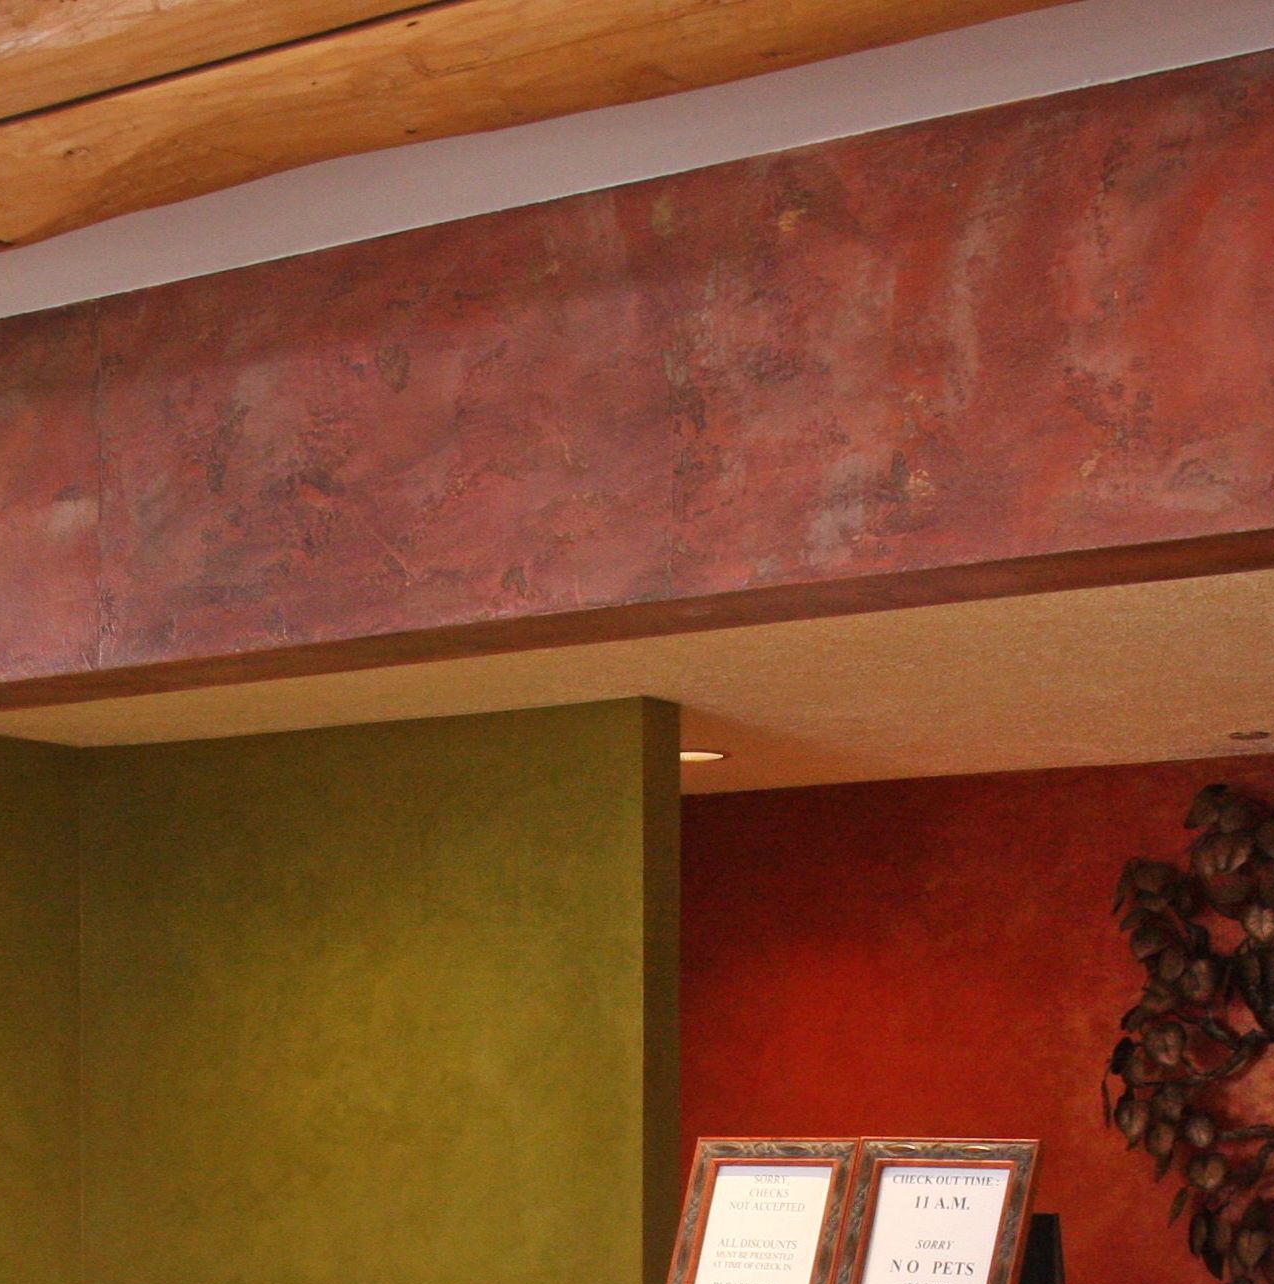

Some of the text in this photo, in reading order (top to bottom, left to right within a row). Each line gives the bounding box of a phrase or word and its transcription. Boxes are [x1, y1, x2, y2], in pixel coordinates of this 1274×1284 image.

[892, 1174, 934, 1186] CHECK
[935, 1175, 959, 1186] OUT
[749, 1188, 790, 1199] CHECKS
[729, 1201, 805, 1213] NOT ACCEPTED
[914, 1196, 971, 1210] 11 A.M.
[719, 1239, 798, 1250] ALL DISCOUNTS
[914, 1240, 955, 1250] SORRY
[890, 1259, 975, 1276] NO PETS
